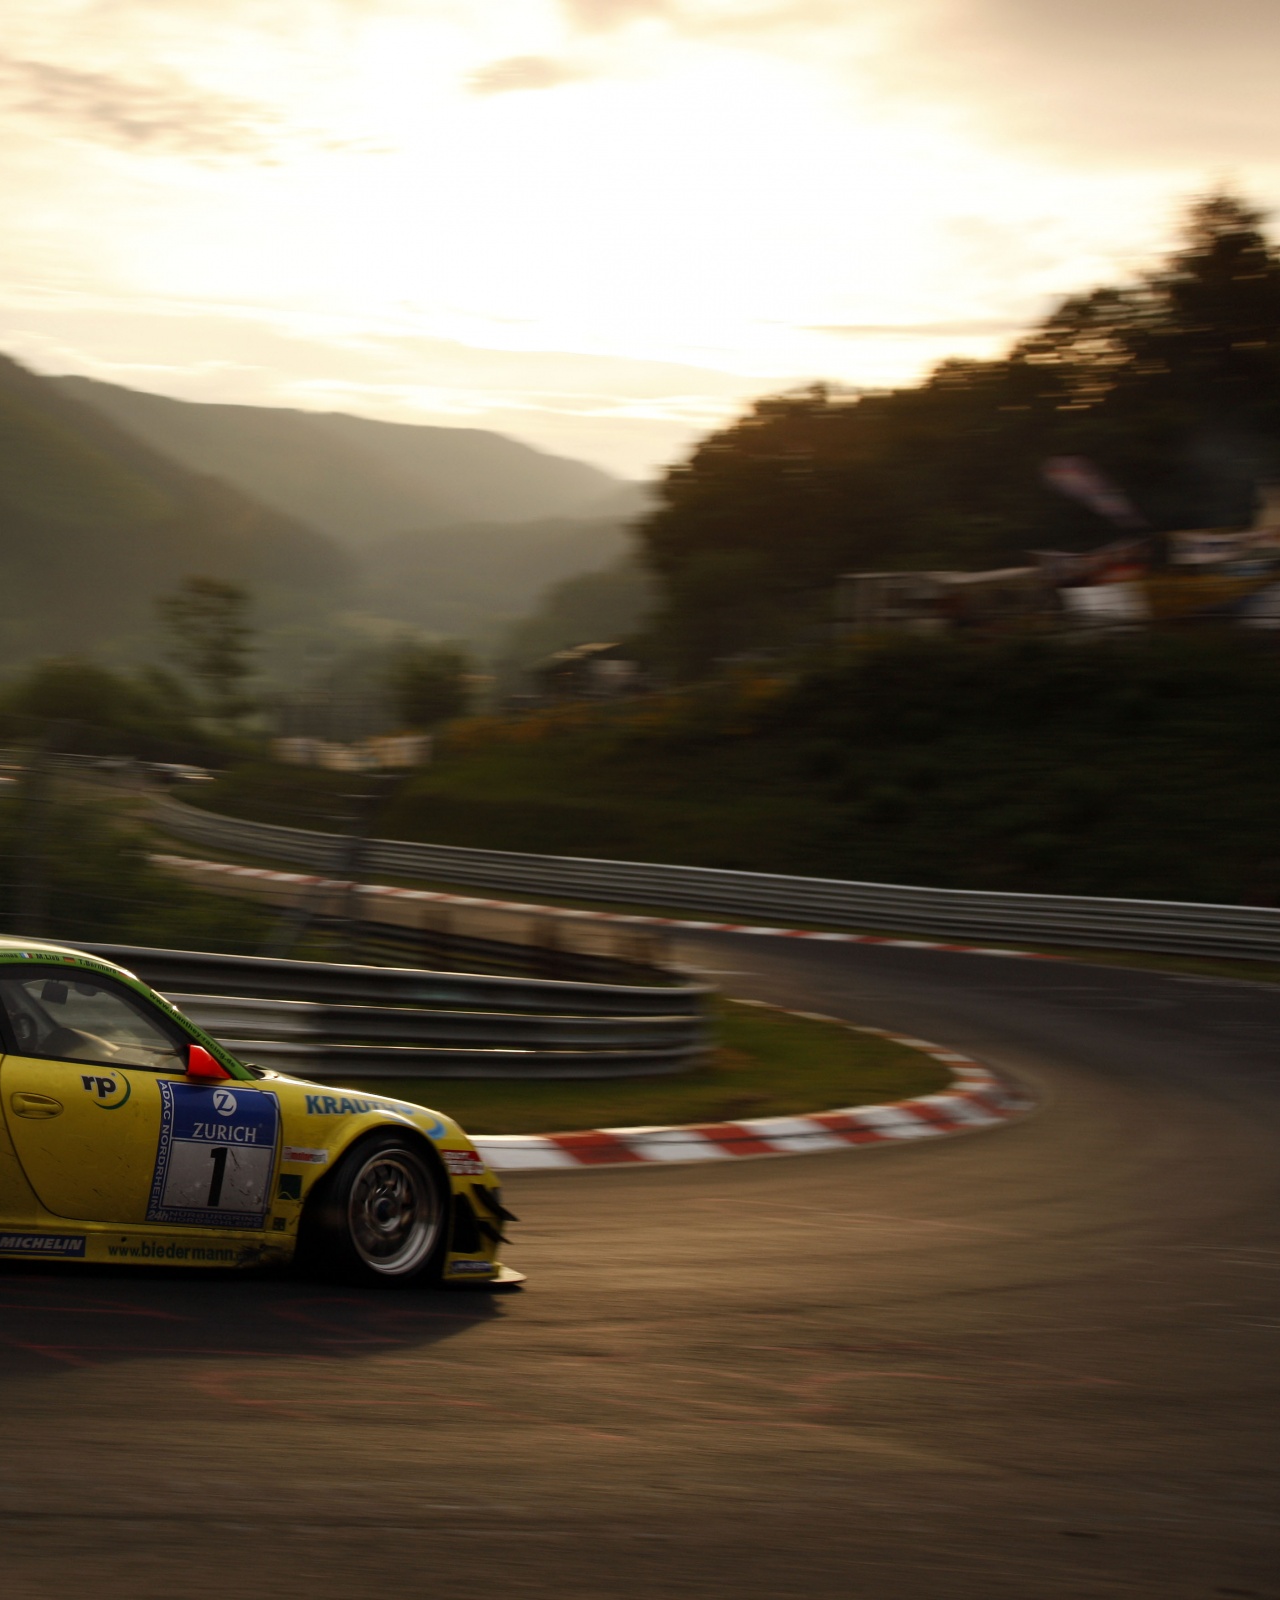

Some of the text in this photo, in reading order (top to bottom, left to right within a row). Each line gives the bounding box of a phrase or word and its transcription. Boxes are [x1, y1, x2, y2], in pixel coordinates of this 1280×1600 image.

[149, 991, 236, 1068] www.manthey-racing.de
[81, 1075, 117, 1098] rp
[192, 1122, 257, 1143] ZURICH
[150, 1081, 171, 1209] ADAC NORDRHEIN
[207, 1147, 228, 1207] 1
[148, 1210, 169, 1222] 24h
[0, 1236, 84, 1250] MICHELIN
